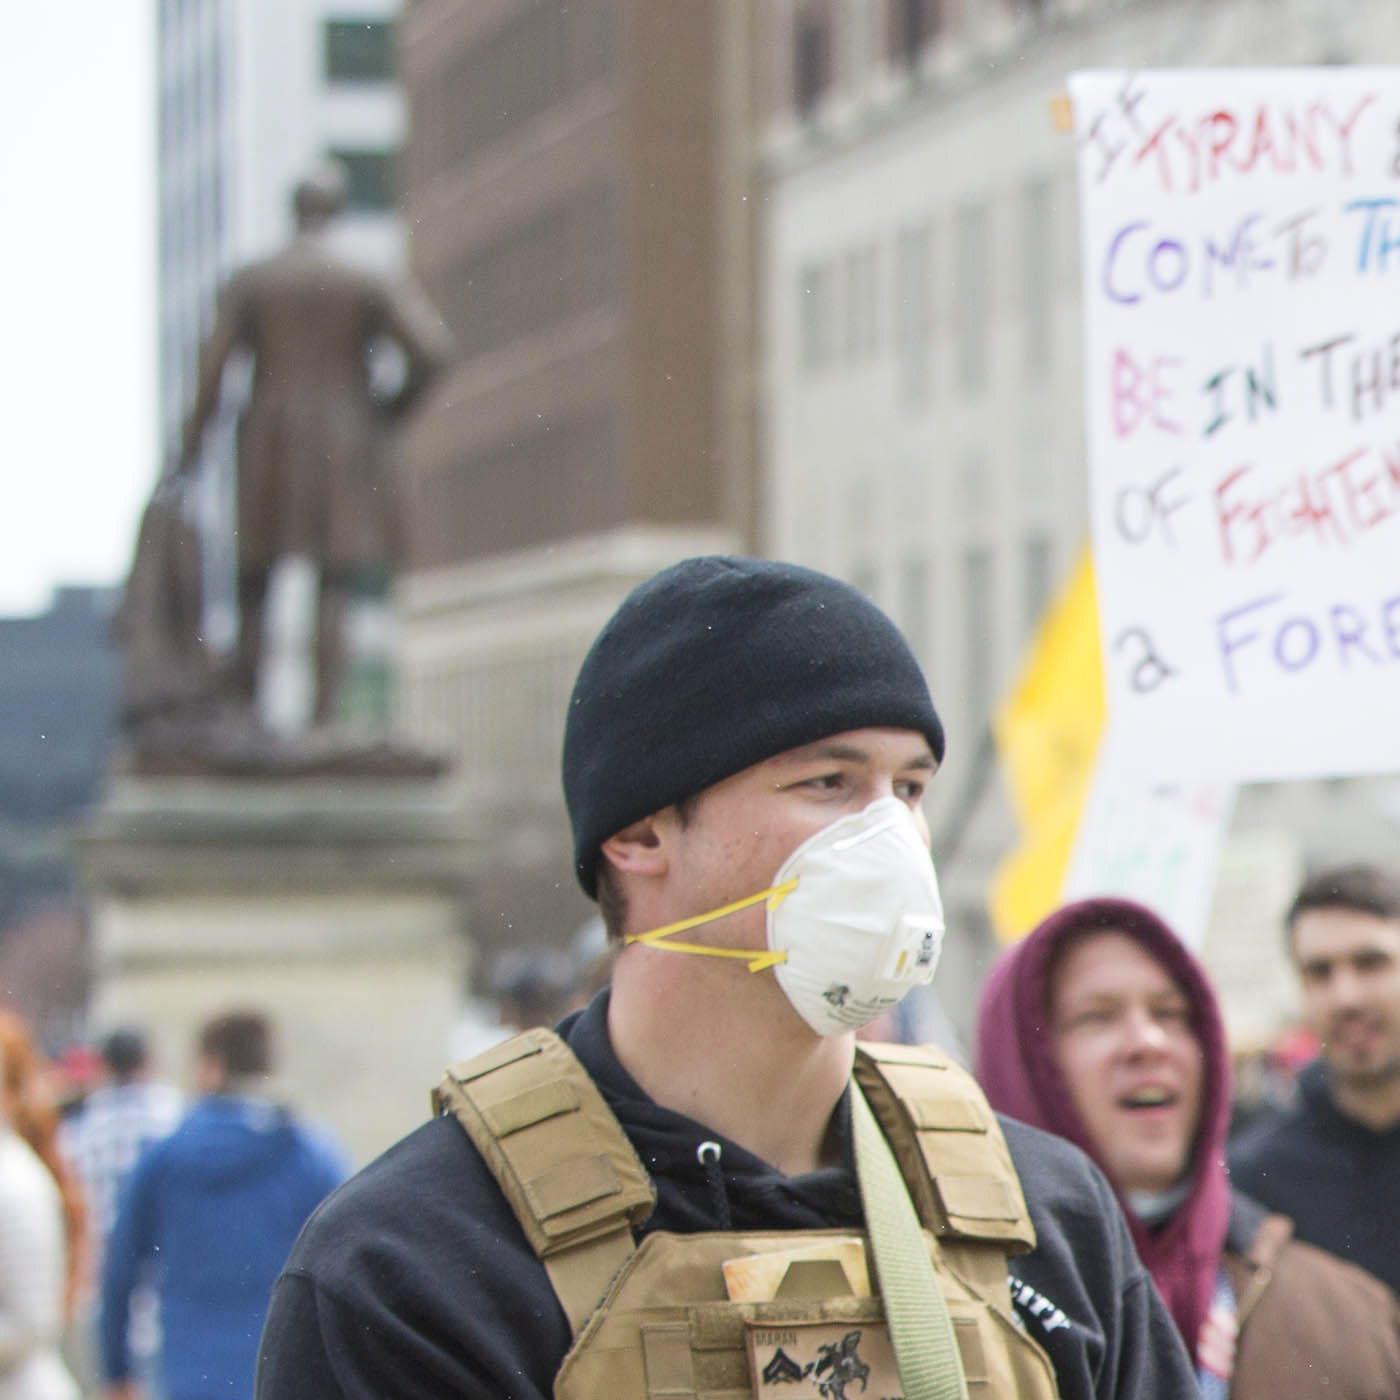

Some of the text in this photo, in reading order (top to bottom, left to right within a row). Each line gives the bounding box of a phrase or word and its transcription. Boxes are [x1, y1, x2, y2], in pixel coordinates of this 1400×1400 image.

[1112, 346, 1187, 440] BE
[1200, 338, 1280, 438] IN
[1114, 464, 1195, 556] OF
